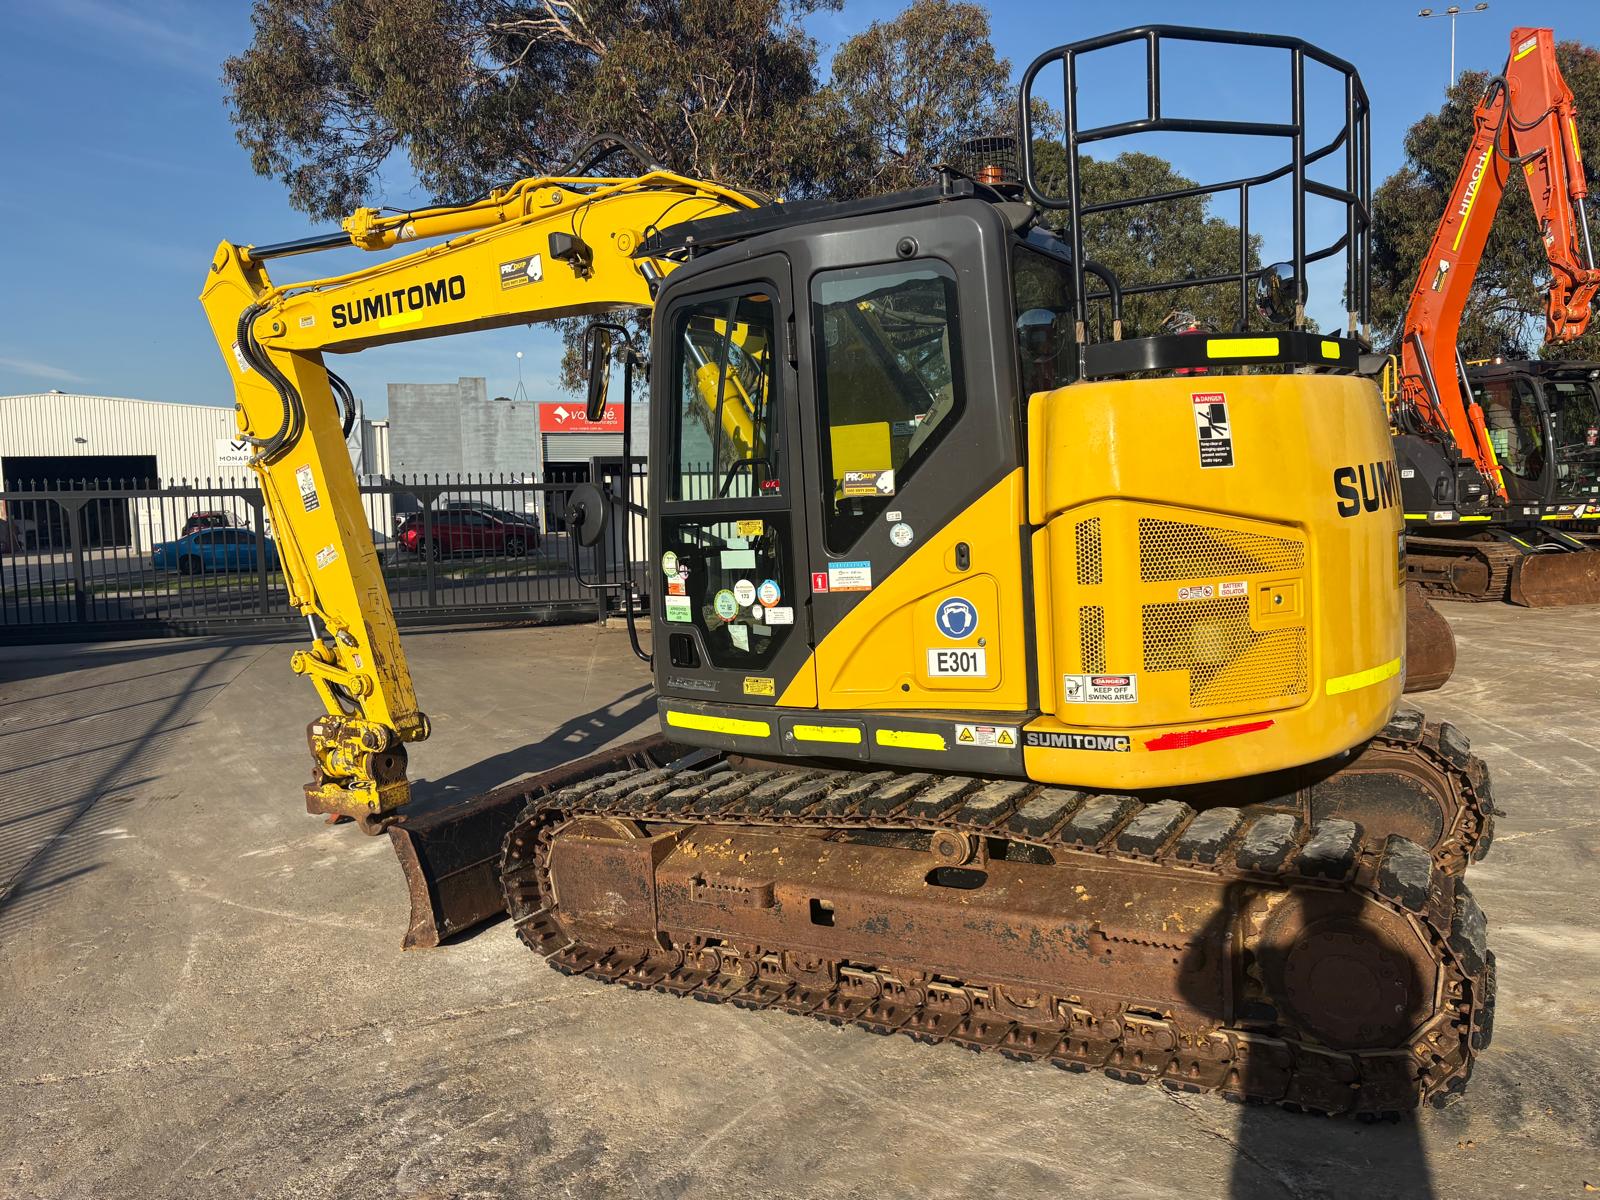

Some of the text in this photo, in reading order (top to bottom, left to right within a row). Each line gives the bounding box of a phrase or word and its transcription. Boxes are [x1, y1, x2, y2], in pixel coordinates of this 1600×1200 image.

[1458, 152, 1487, 216] HITACHI
[331, 274, 466, 329] SUMITOMO
[937, 652, 977, 672] E301
